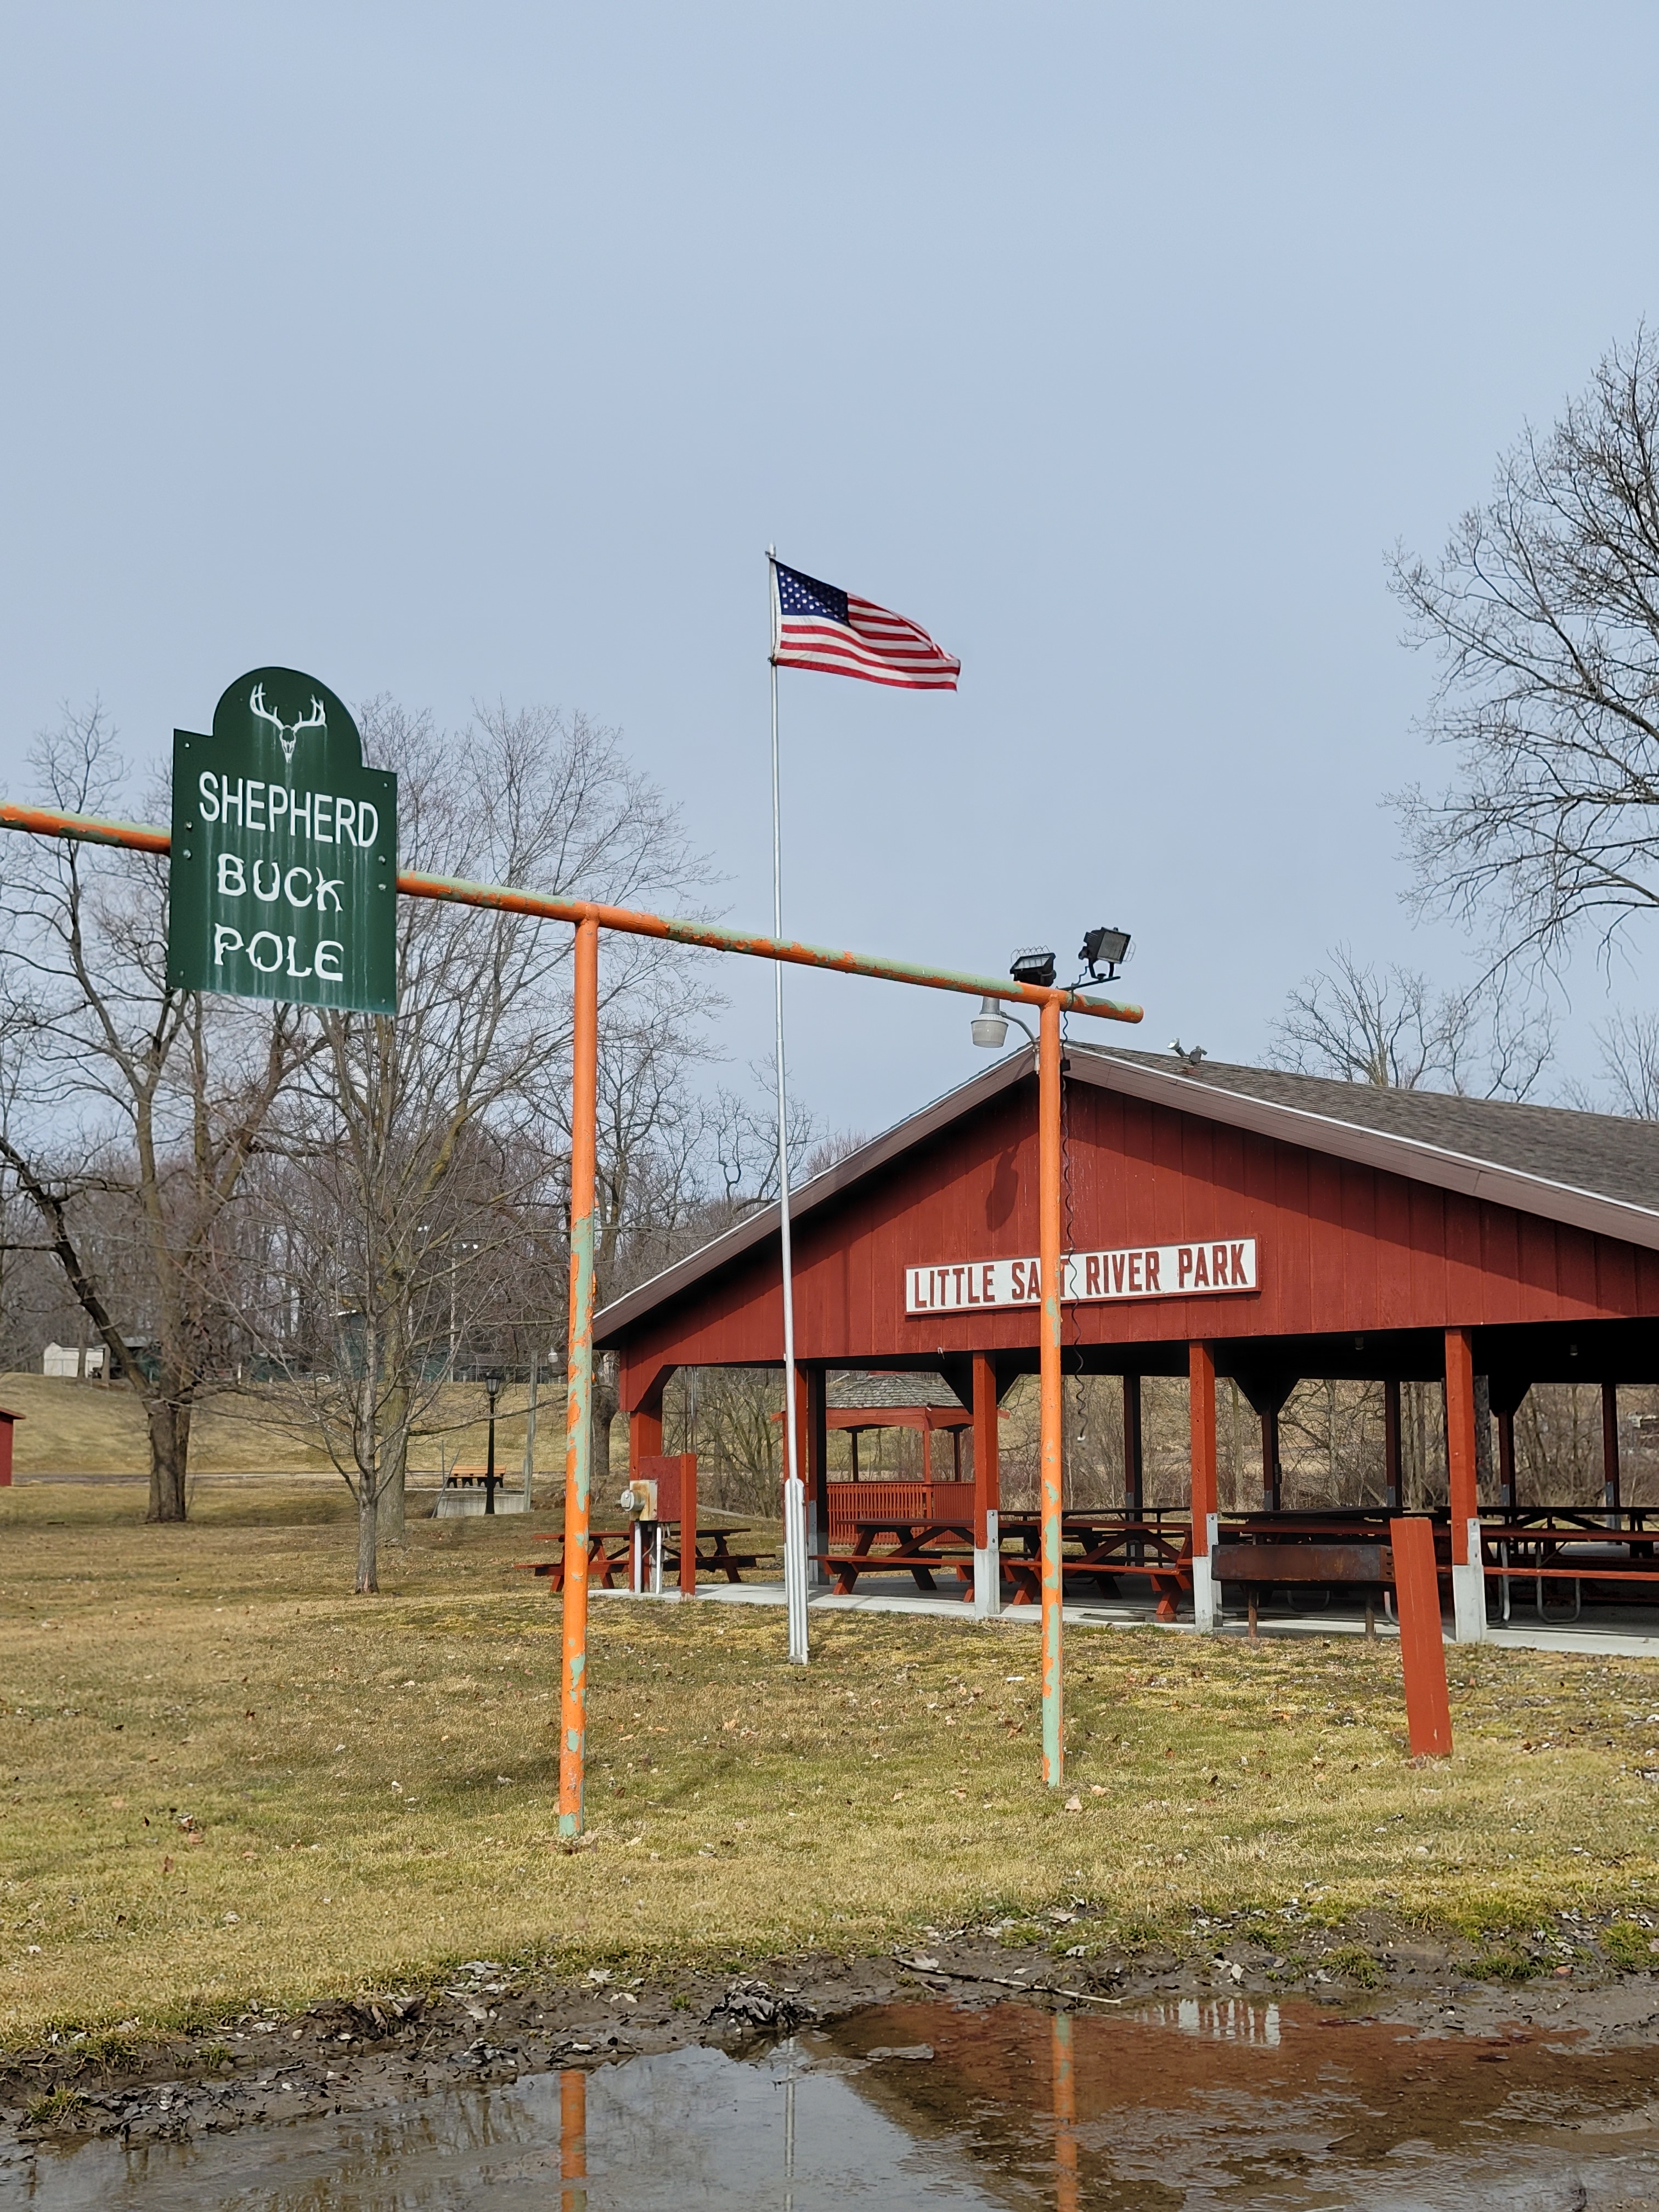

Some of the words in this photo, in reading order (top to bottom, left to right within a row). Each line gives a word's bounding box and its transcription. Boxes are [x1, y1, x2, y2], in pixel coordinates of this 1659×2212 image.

[199, 771, 379, 848] SHEPHERD
[217, 853, 345, 912] BUCK
[214, 922, 345, 982] POLE
[915, 1264, 996, 1308] LITTLE
[1012, 1259, 1070, 1300] SAT
[1086, 1250, 1161, 1296] RIVER
[1178, 1243, 1249, 1289] PARK
